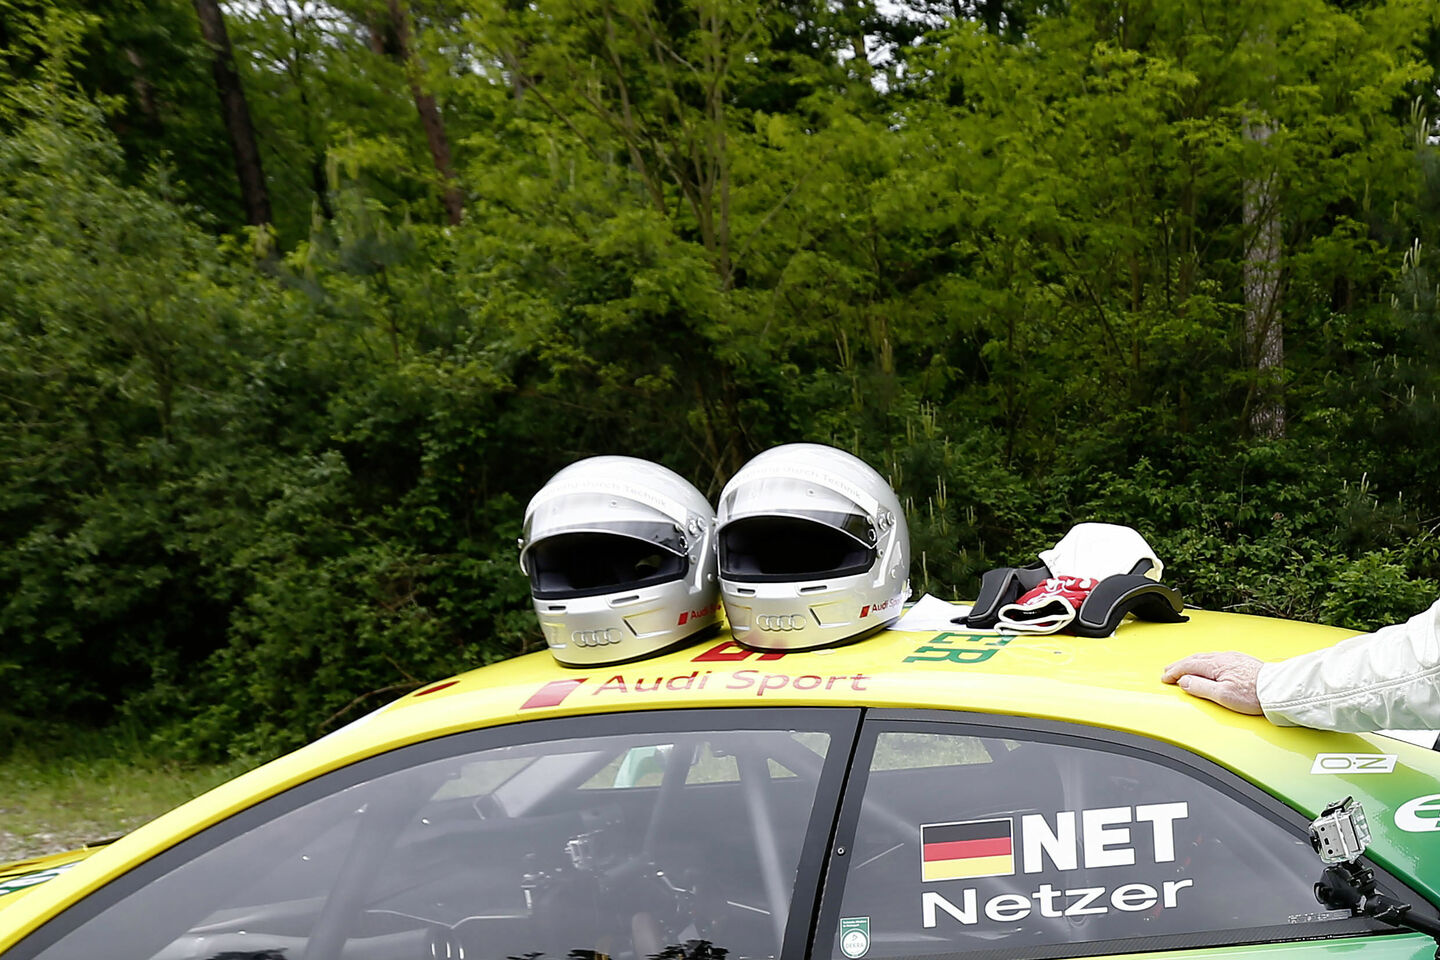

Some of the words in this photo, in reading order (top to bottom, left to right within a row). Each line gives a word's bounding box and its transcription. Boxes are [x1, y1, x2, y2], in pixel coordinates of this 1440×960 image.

[592, 670, 712, 695] Audi
[725, 669, 872, 697] Sport
[1021, 801, 1190, 875] NET
[921, 878, 1194, 929] Netzer
